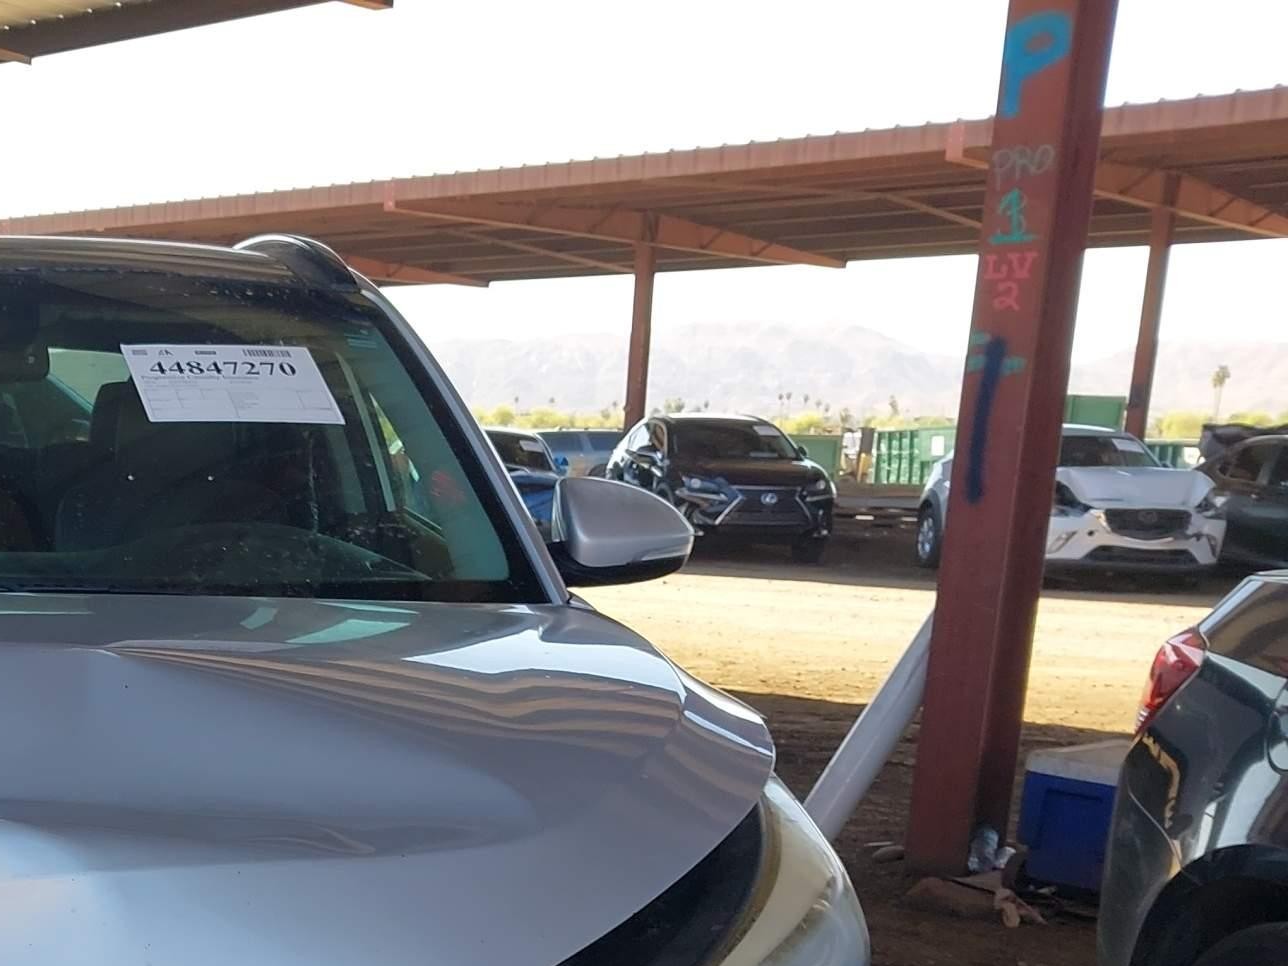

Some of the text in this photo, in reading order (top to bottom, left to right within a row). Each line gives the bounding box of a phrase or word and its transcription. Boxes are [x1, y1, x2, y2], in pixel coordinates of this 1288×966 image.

[1003, 9, 1073, 119] P
[992, 281, 1021, 312] 2
[149, 360, 297, 377] 44847270
